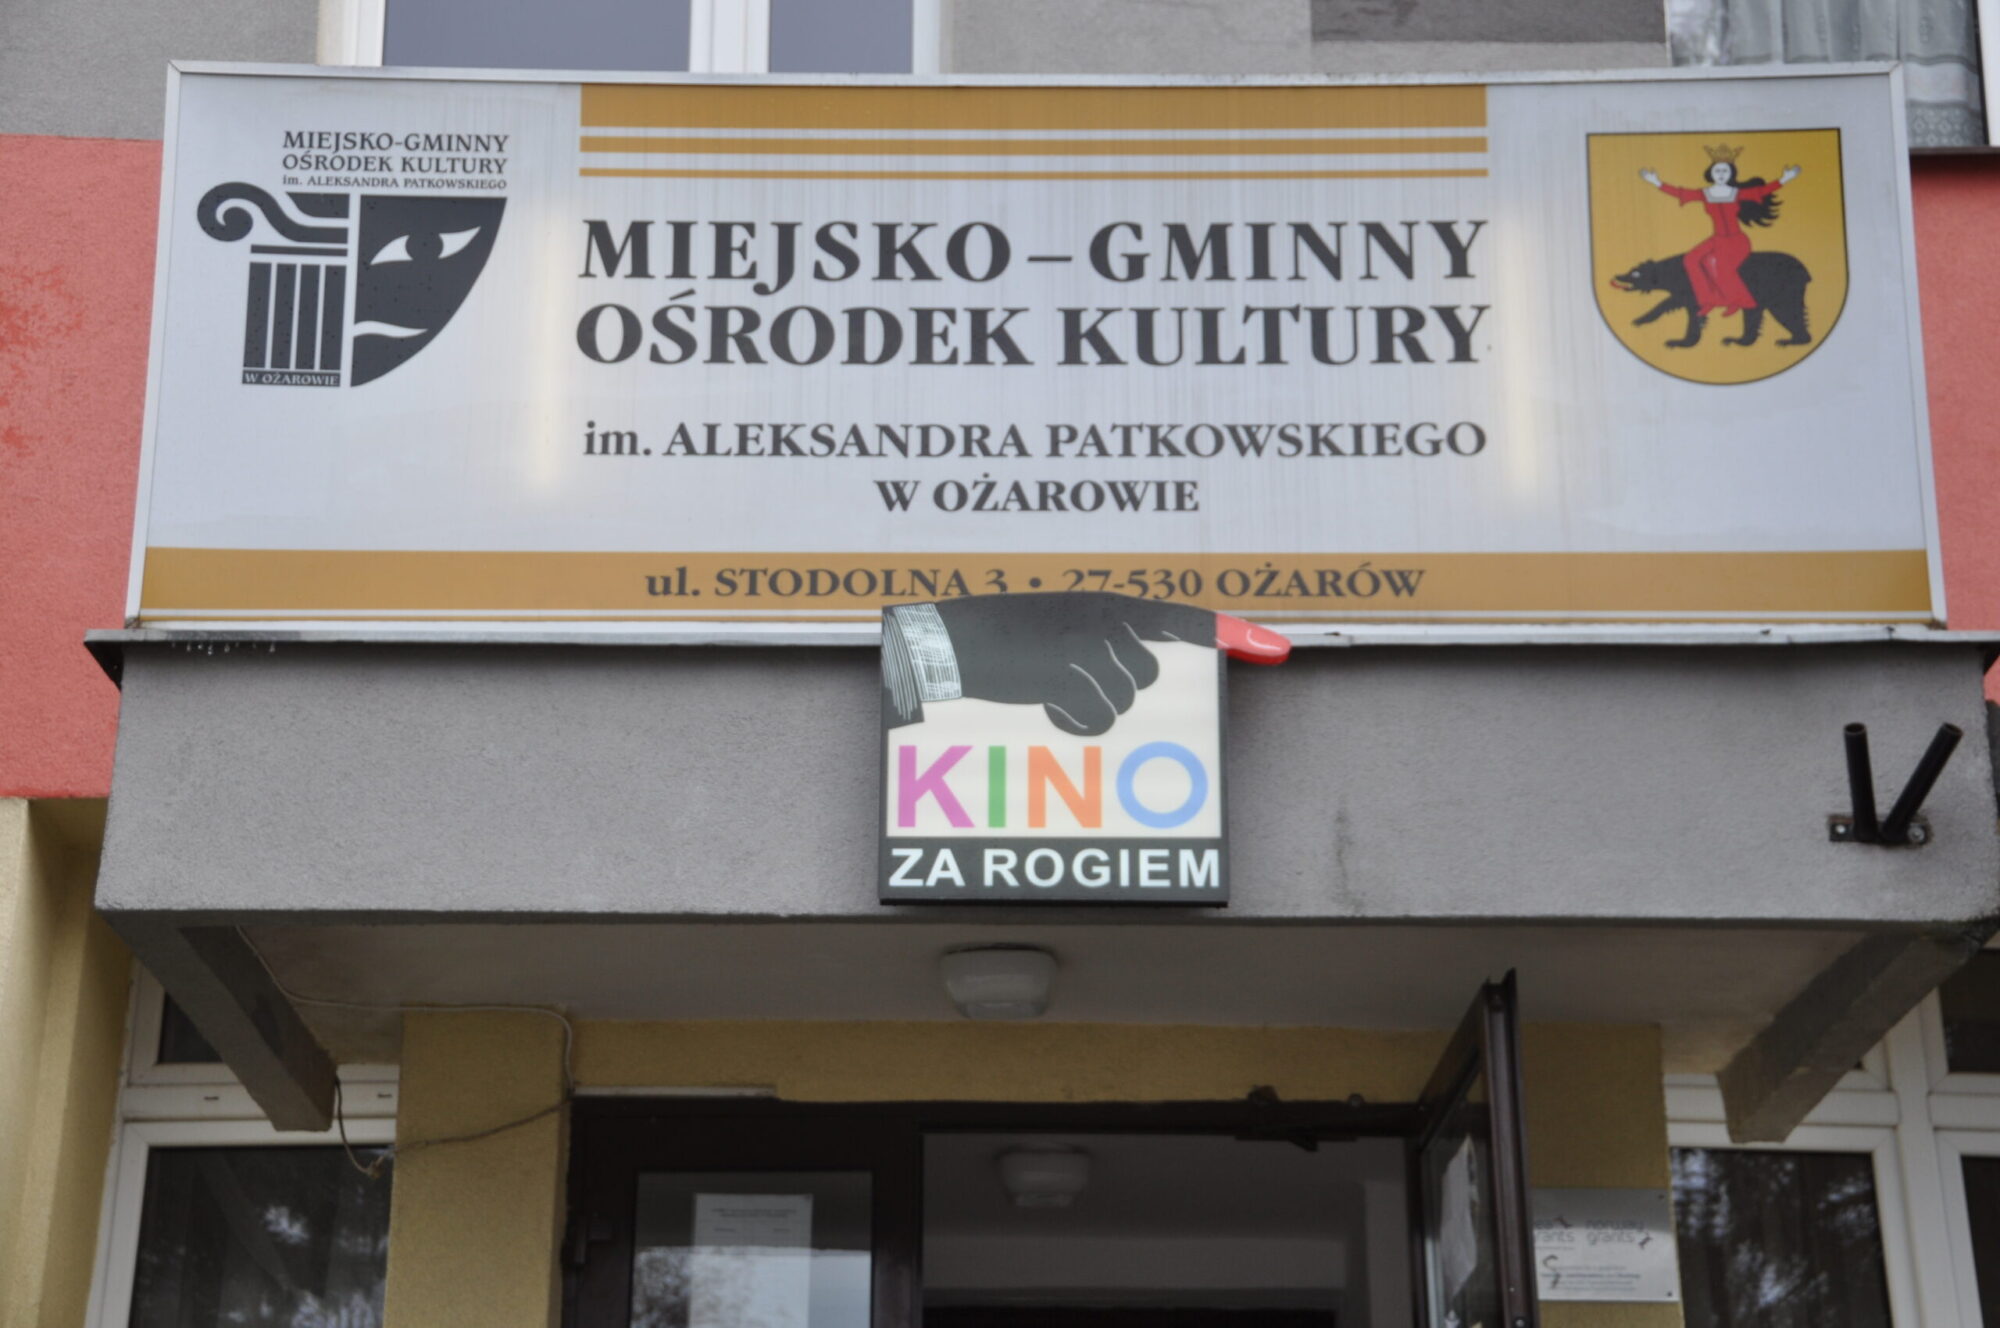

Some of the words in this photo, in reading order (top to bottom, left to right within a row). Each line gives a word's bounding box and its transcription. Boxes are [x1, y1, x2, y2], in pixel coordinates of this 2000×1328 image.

[283, 131, 509, 153] MIEJSKO-GMINNY
[283, 150, 394, 173] OŚRODEK
[401, 157, 508, 174] KULTURY
[283, 175, 302, 186] im.
[307, 175, 399, 188] ALEKSANDRA
[403, 178, 508, 190] PATKOWSKIEGO
[576, 289, 1035, 366] OŚRODEK
[1057, 303, 1491, 366] KULTURY
[261, 371, 339, 386] OŻAROWIE
[583, 420, 652, 456] im.
[662, 421, 1032, 458] ALEKSANDRA
[1045, 421, 1487, 457] PATKOWSKIEGO
[932, 472, 1200, 512] OŻAROWIE
[645, 566, 701, 597] ul.
[713, 567, 973, 597] STODOLNA
[984, 568, 1009, 594] 3
[1062, 568, 1204, 600] 27-530
[1216, 562, 1426, 598] OŻARÓW
[897, 741, 1209, 829] KINO
[889, 848, 966, 887] ZA
[983, 848, 1220, 887] ROGIEM
